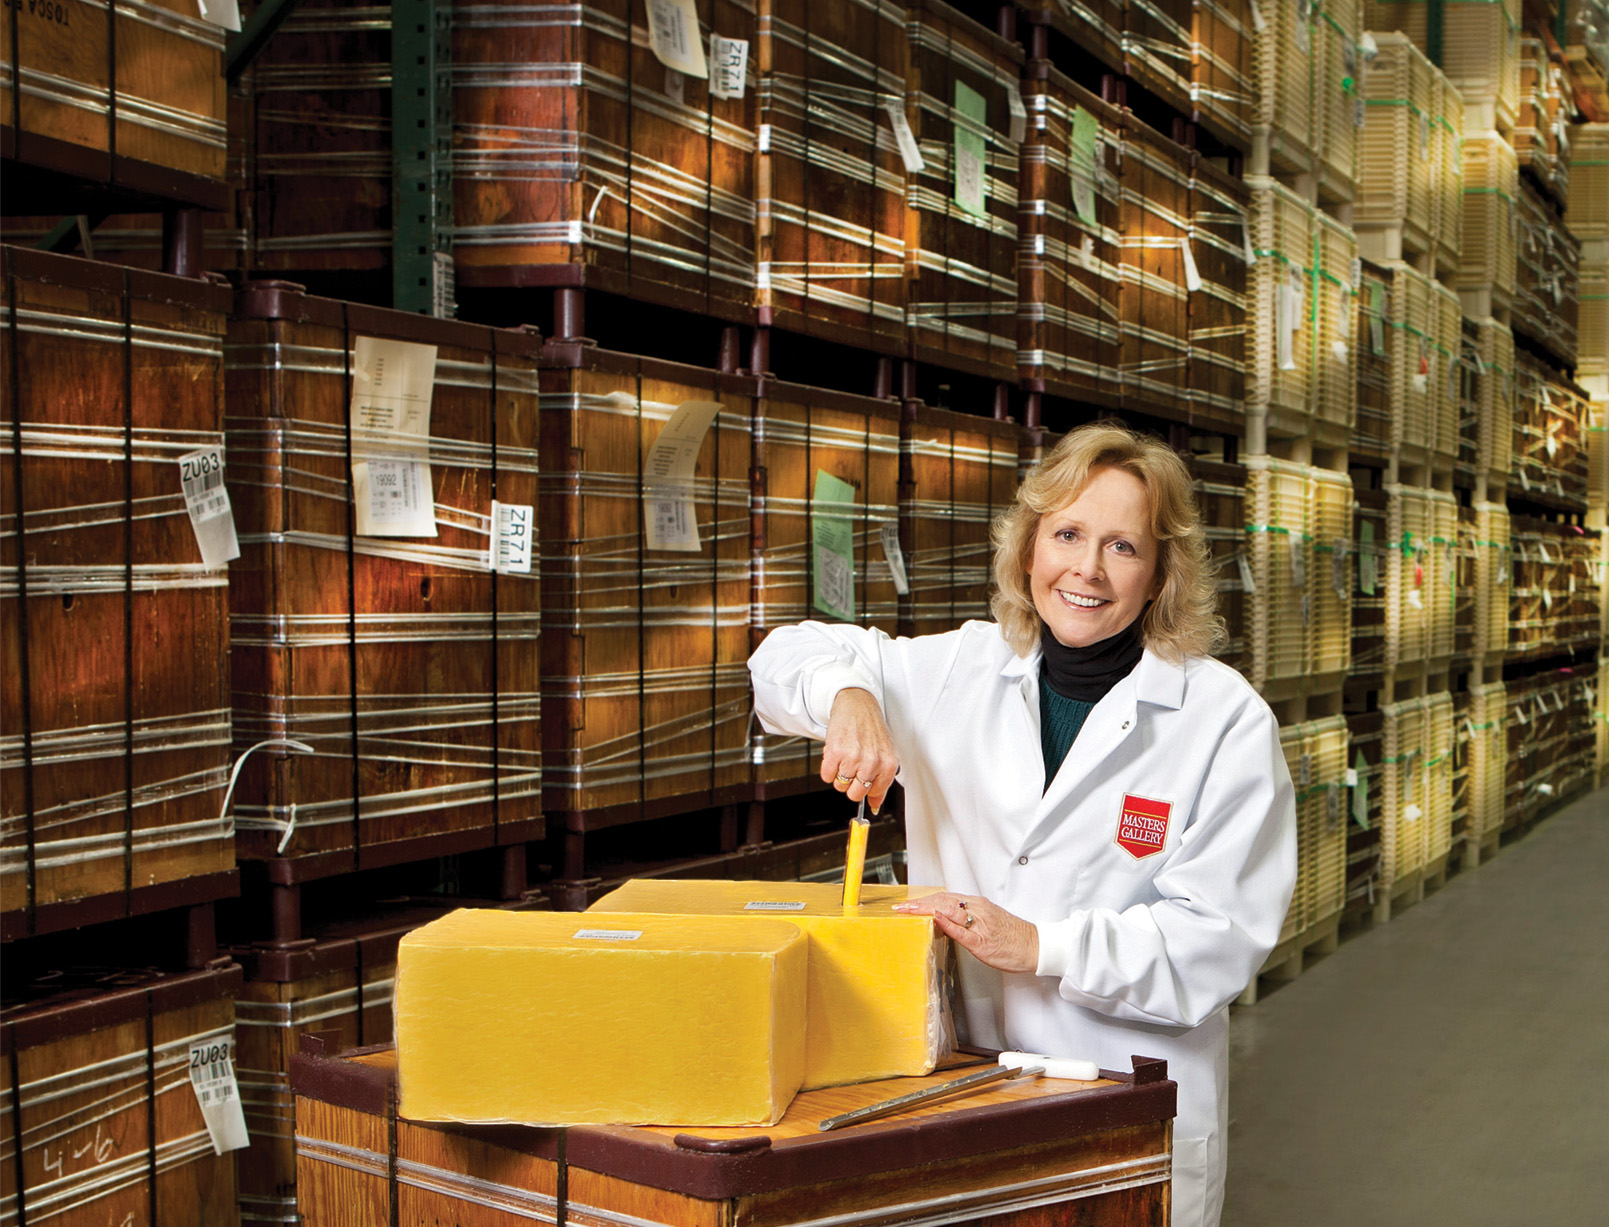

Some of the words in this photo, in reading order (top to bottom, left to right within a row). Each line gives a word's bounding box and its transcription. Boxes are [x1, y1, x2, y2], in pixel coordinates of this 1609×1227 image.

[729, 42, 742, 91] ZR71
[182, 452, 220, 482] ZU03
[510, 508, 526, 564] ZR71
[1121, 826, 1164, 845] GALLERY
[1122, 813, 1166, 833] MASTERS
[191, 1042, 229, 1069] ZU03
